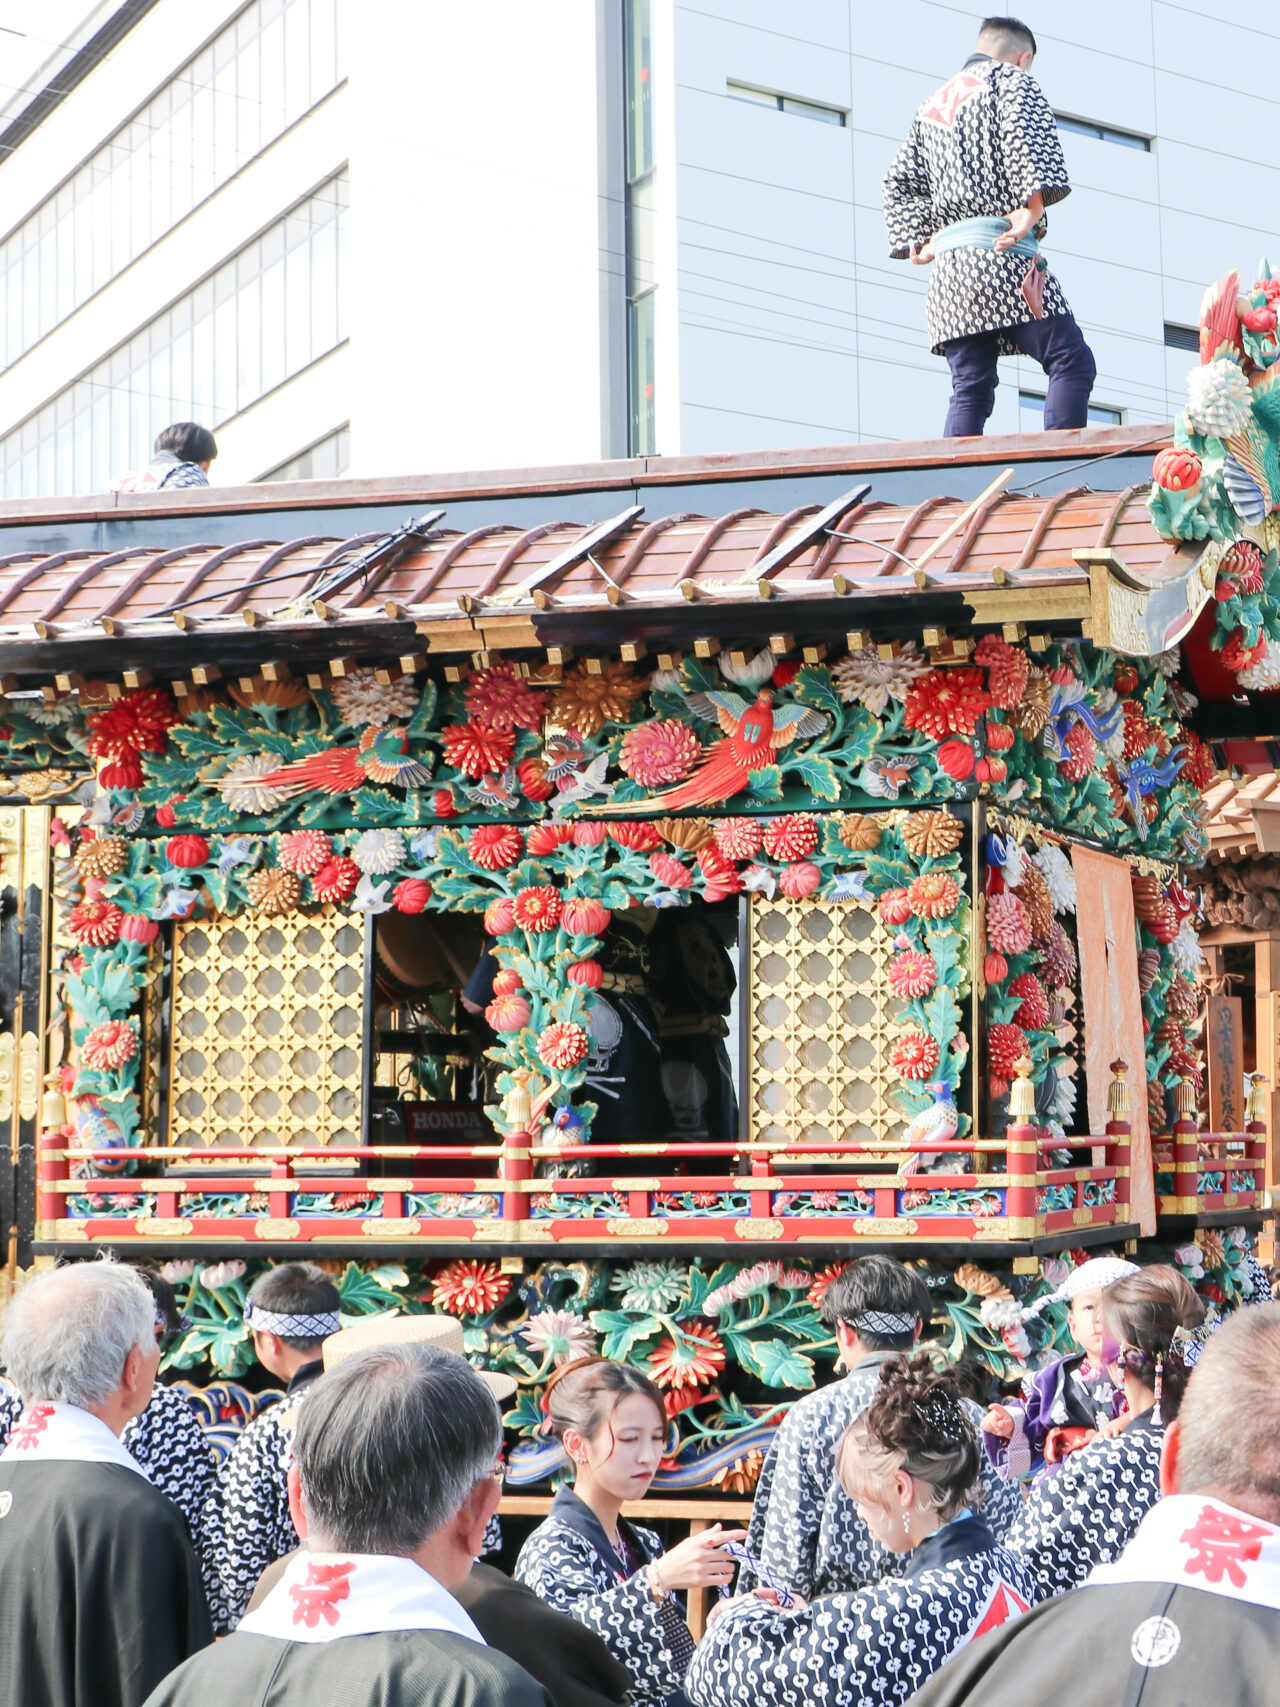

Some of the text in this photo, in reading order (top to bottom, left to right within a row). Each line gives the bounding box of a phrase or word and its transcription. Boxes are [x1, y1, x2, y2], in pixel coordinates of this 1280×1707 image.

[412, 1111, 482, 1129] HONDA
[1179, 1504, 1274, 1589] 祭
[288, 1560, 358, 1629] 祭
